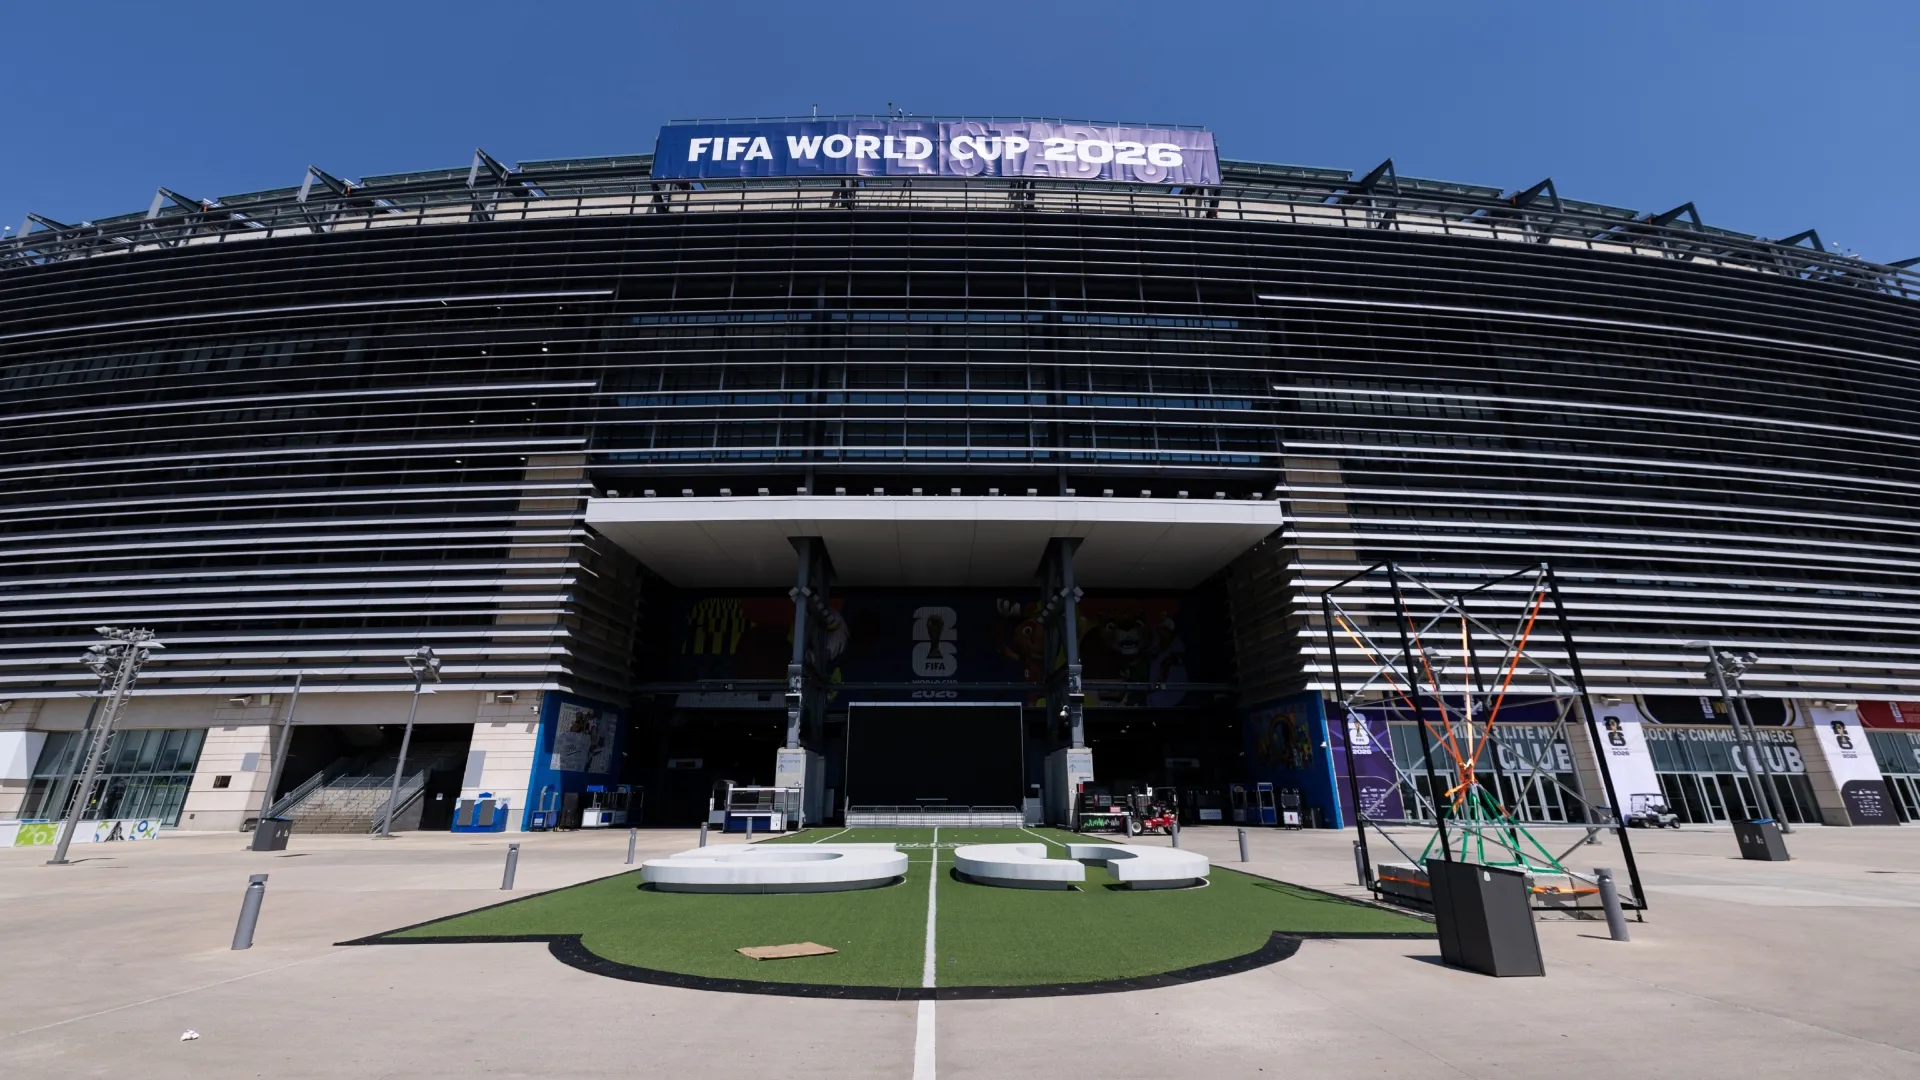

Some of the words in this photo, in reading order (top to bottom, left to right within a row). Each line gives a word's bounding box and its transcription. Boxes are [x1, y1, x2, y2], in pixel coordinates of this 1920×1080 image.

[688, 136, 773, 162] FIFA
[786, 133, 933, 160] WORLD
[950, 135, 1030, 161] CUP
[1043, 137, 1183, 167] 2026
[925, 662, 945, 670] FIFA
[912, 689, 958, 698] 2026
[1502, 726, 1537, 739] LITE
[1497, 743, 1573, 770] CLUB
[1731, 745, 1804, 772] CLUB
